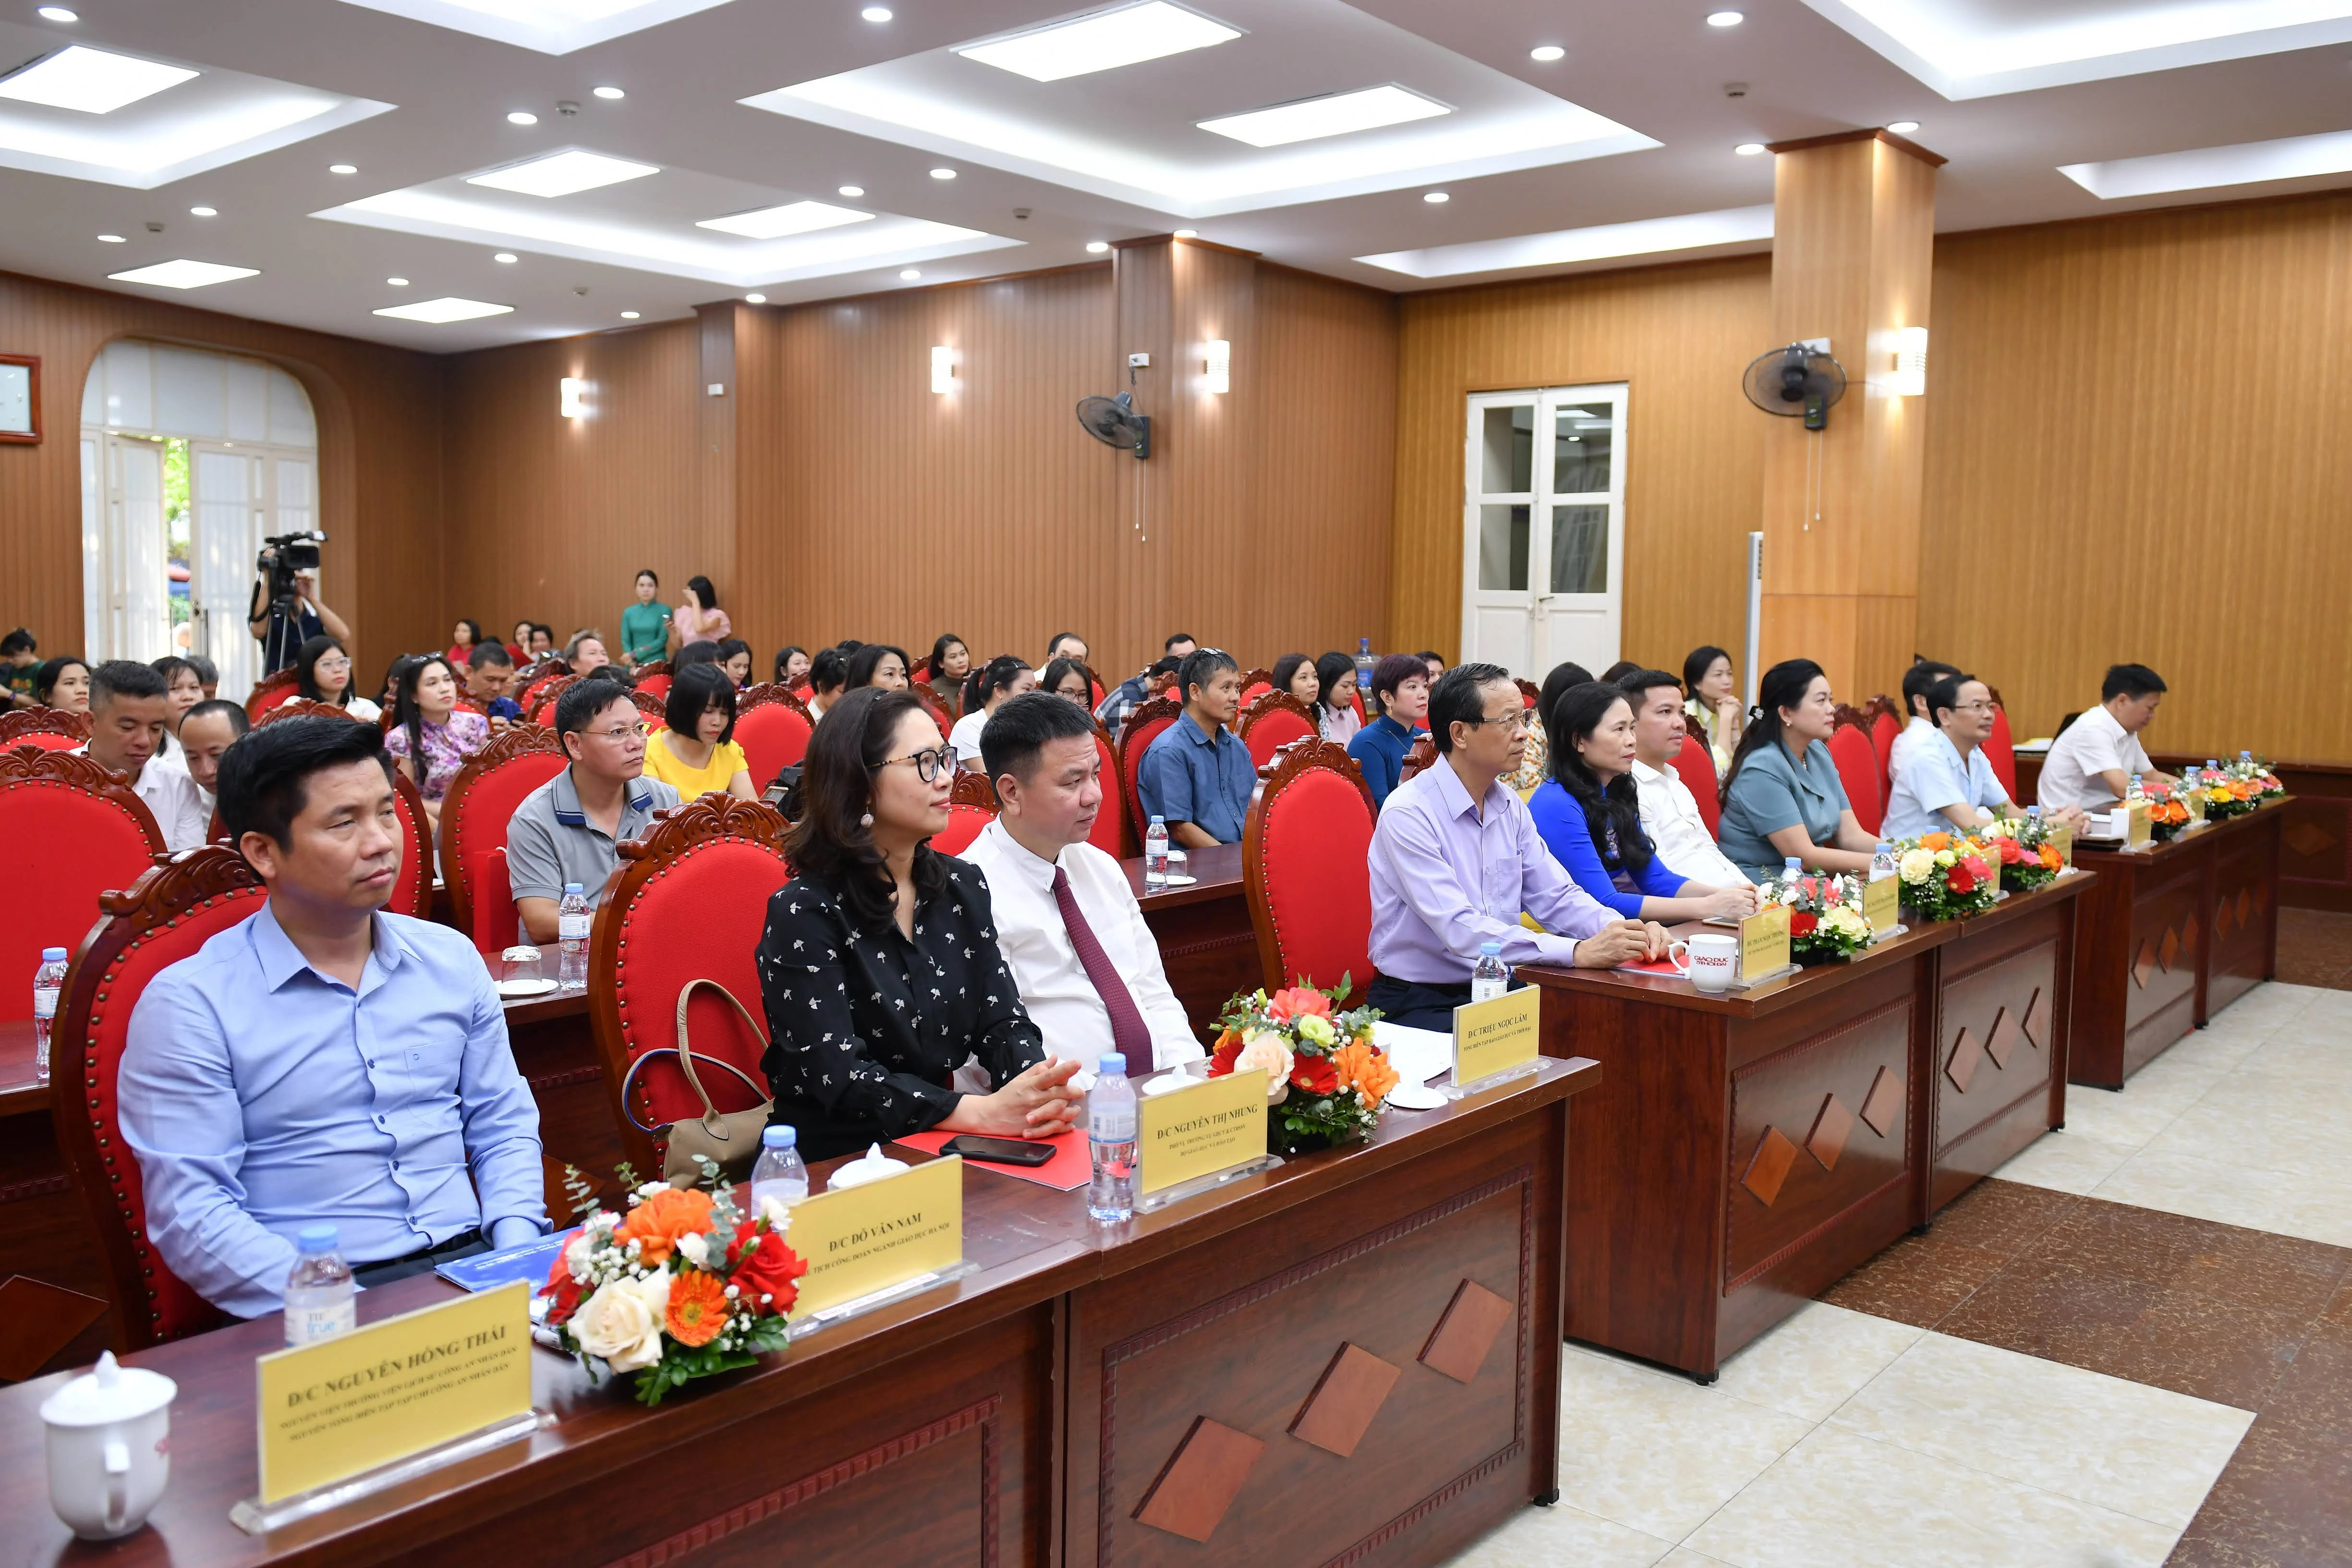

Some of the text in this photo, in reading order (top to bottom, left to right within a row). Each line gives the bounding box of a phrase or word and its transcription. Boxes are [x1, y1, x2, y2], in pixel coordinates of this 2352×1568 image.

[1468, 1013, 1528, 1039] Đ/C TRIỆU NGỌC LÂM
[1157, 1105, 1258, 1139] Đ/C NGUYỄN THỊ NHUNG
[829, 1236, 849, 1252] Đ/C
[871, 1220, 894, 1237] VĂN
[897, 1213, 922, 1230] NAM
[464, 1325, 506, 1349] THÁI
